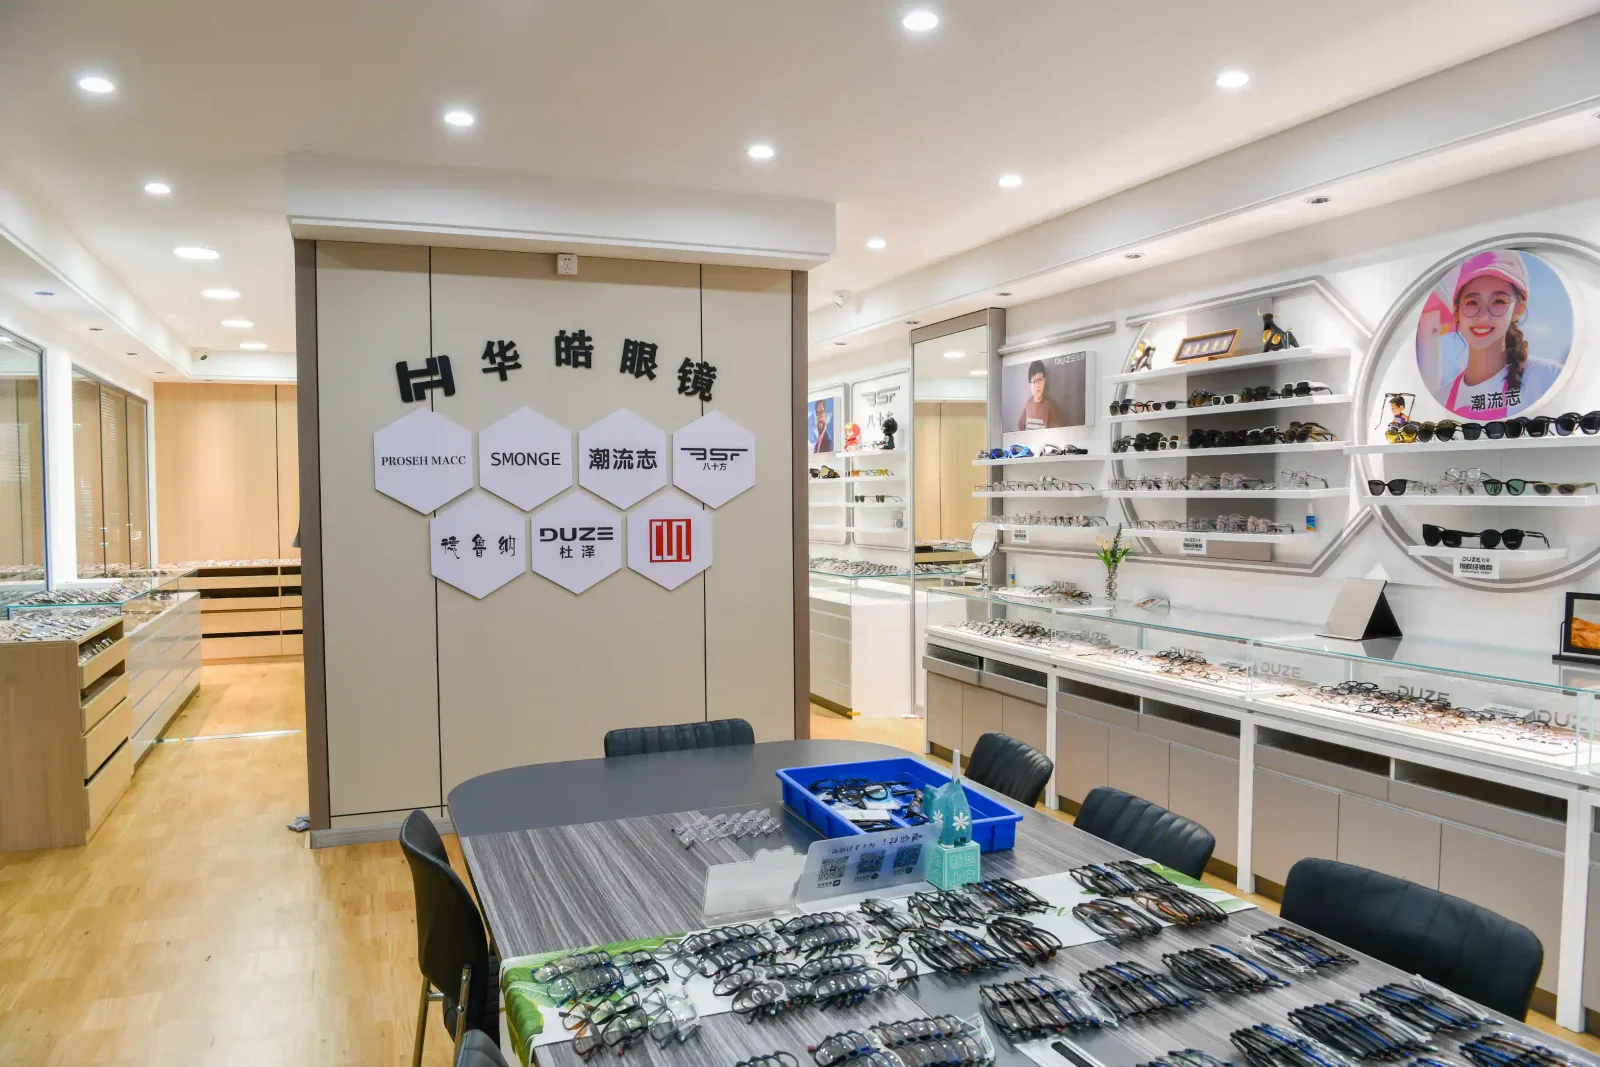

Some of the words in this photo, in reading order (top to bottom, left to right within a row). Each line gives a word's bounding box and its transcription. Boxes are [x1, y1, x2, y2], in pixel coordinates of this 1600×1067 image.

[481, 329, 718, 402] 华皓眼镜
[1470, 389, 1521, 411] 潮流志
[381, 456, 429, 466] PROSEH
[431, 455, 466, 465] MACC
[490, 452, 562, 467] SMONGE
[588, 448, 658, 470] 潮流志
[702, 462, 727, 471] 八十方
[539, 526, 614, 542] DUZE
[559, 545, 596, 559] 杜泽
[1261, 662, 1302, 679] DUZE
